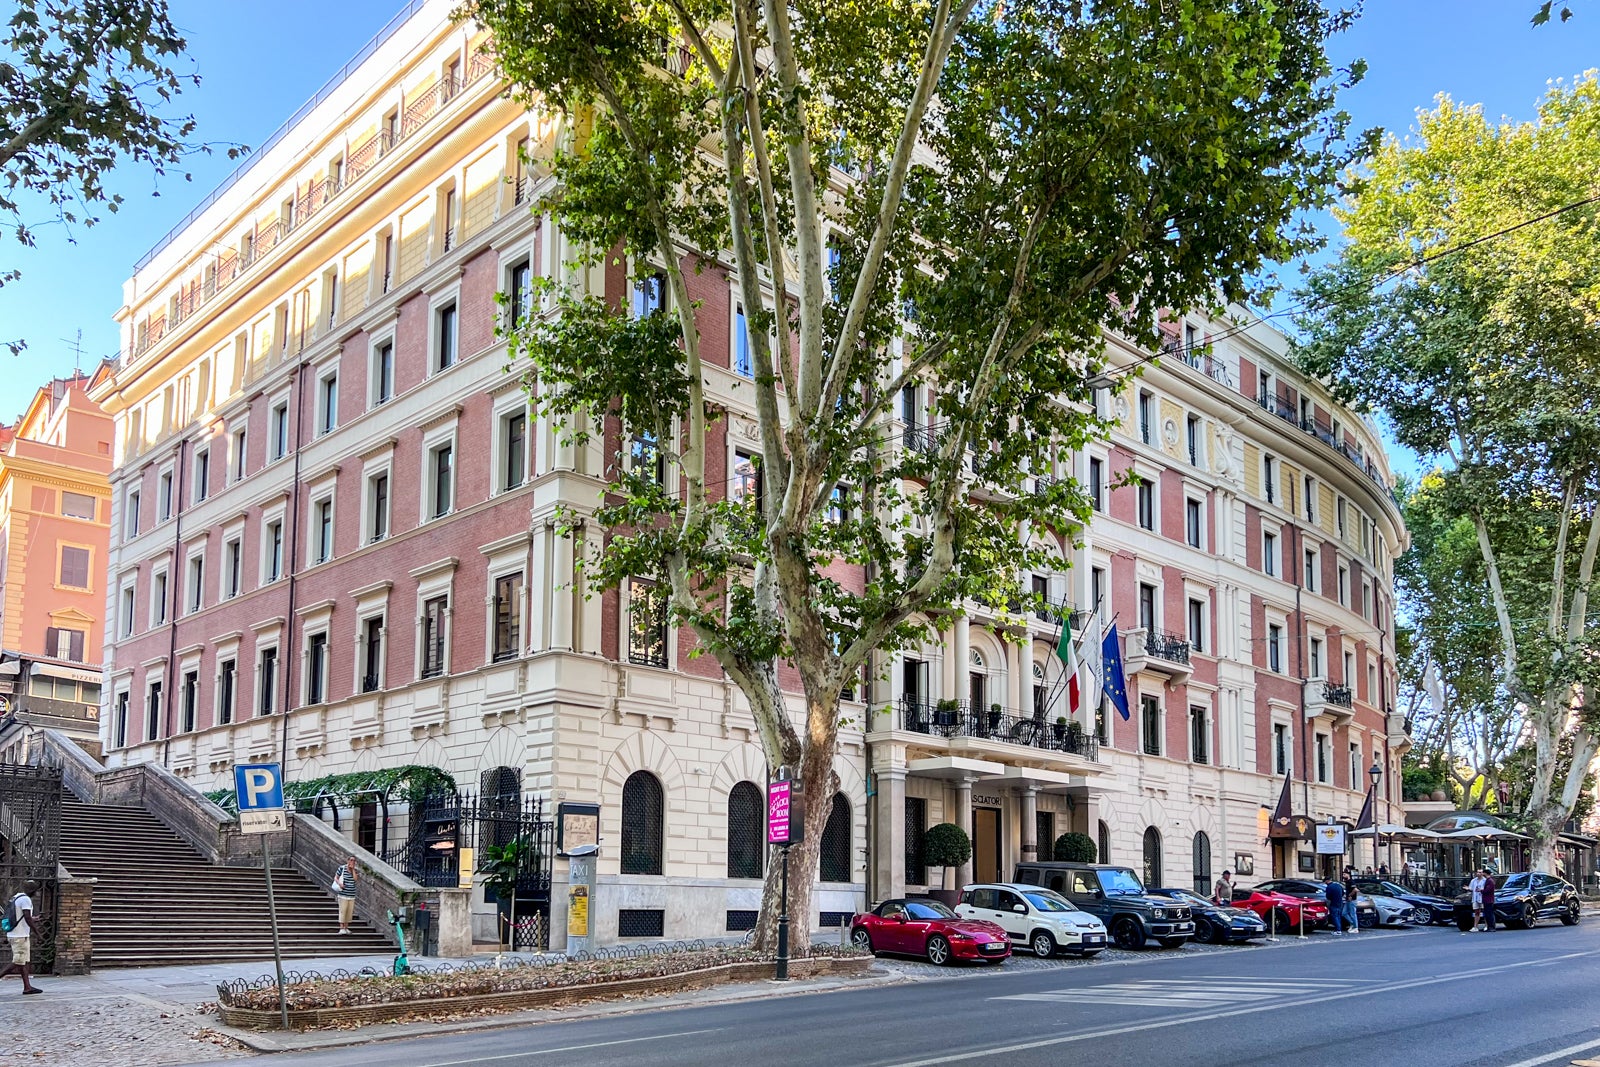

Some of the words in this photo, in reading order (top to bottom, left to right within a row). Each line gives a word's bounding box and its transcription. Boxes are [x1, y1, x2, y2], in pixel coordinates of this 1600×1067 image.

[86, 705, 97, 719] R
[244, 768, 275, 807] P
[570, 864, 588, 876] TAXI
